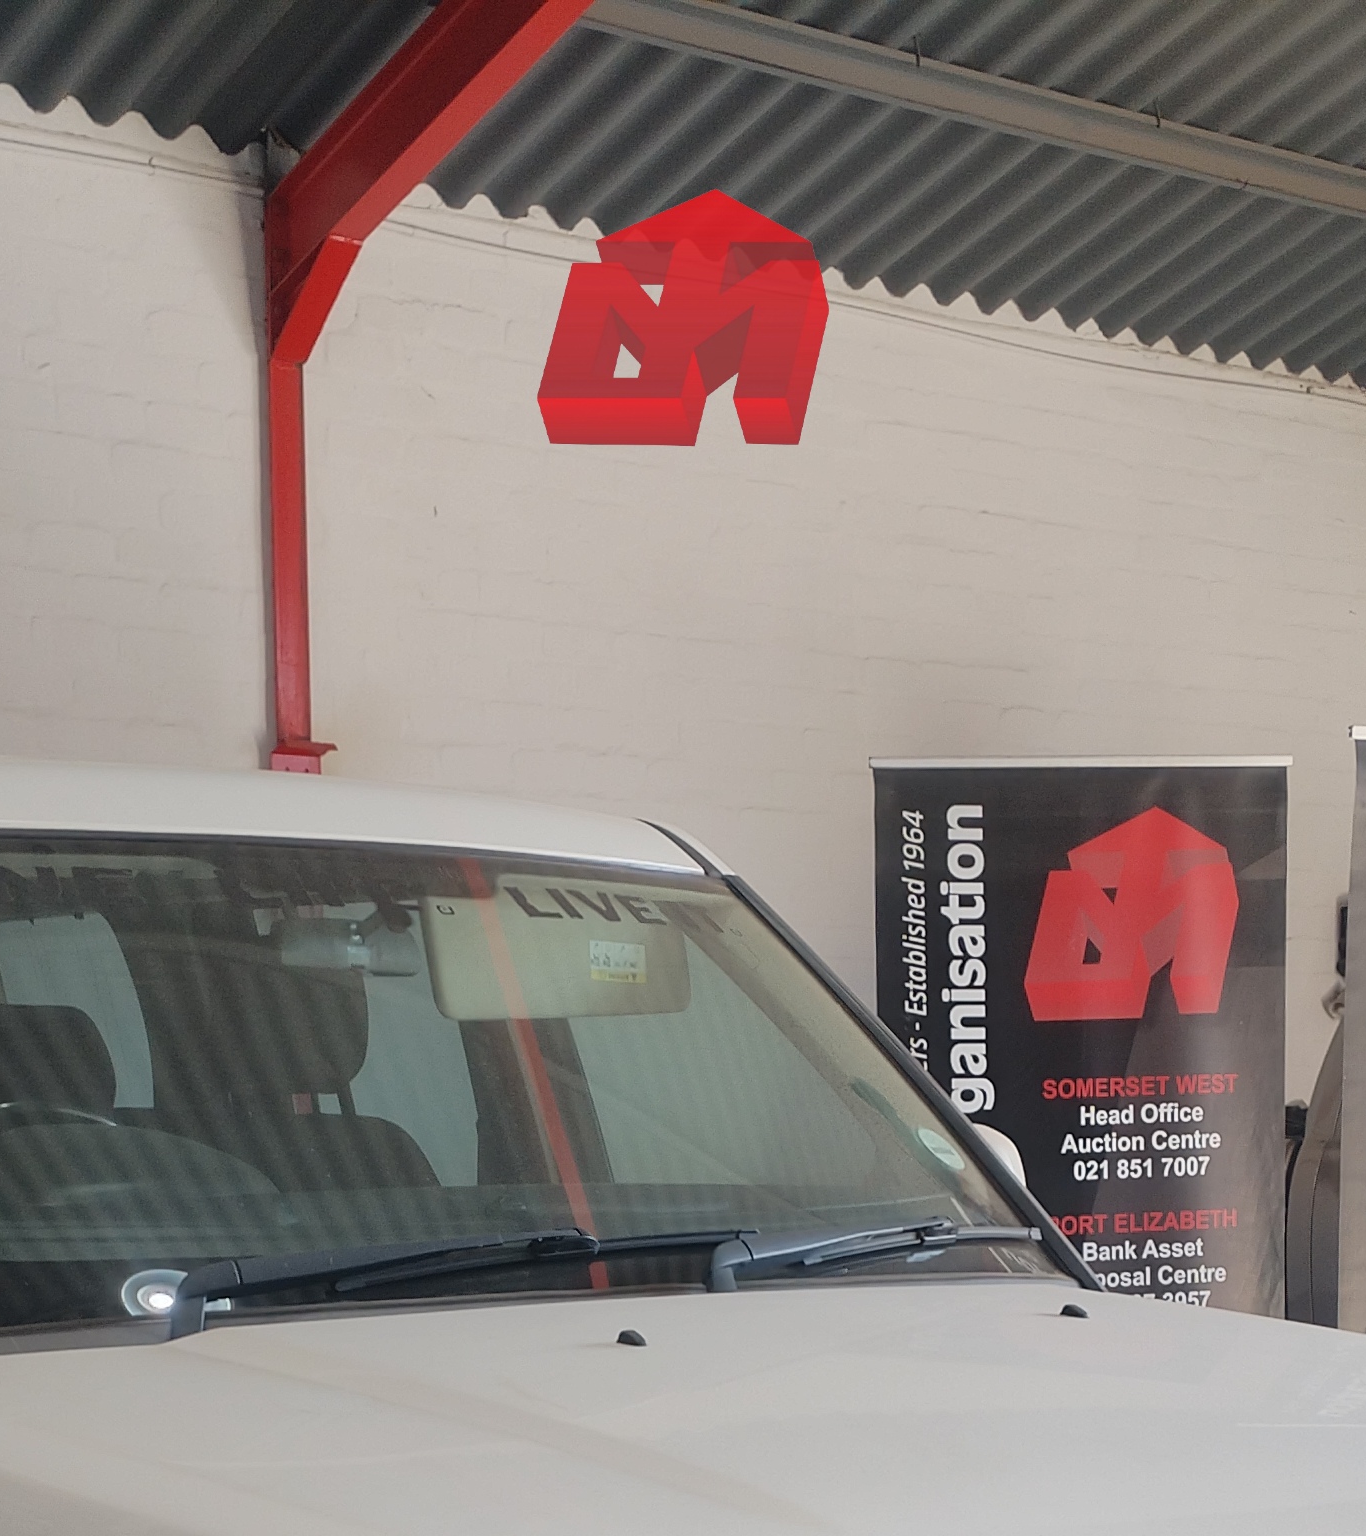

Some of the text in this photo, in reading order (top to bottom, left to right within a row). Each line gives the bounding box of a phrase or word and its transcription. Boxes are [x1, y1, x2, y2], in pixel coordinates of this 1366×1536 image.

[901, 810, 925, 871] 1964
[503, 885, 668, 926] LIVE
[901, 876, 928, 1017] Established
[939, 804, 996, 1114] ganisation
[1041, 1073, 1239, 1099] SOMERSET WEST
[1079, 1102, 1204, 1126] Head Office
[1060, 1129, 1222, 1155] Auction Centre
[1072, 1156, 1211, 1182] 021 851 7007
[1113, 1207, 1238, 1234] ELIZABETH
[1082, 1237, 1204, 1262] Bank Asset
[1094, 1264, 1227, 1288] posal Centre
